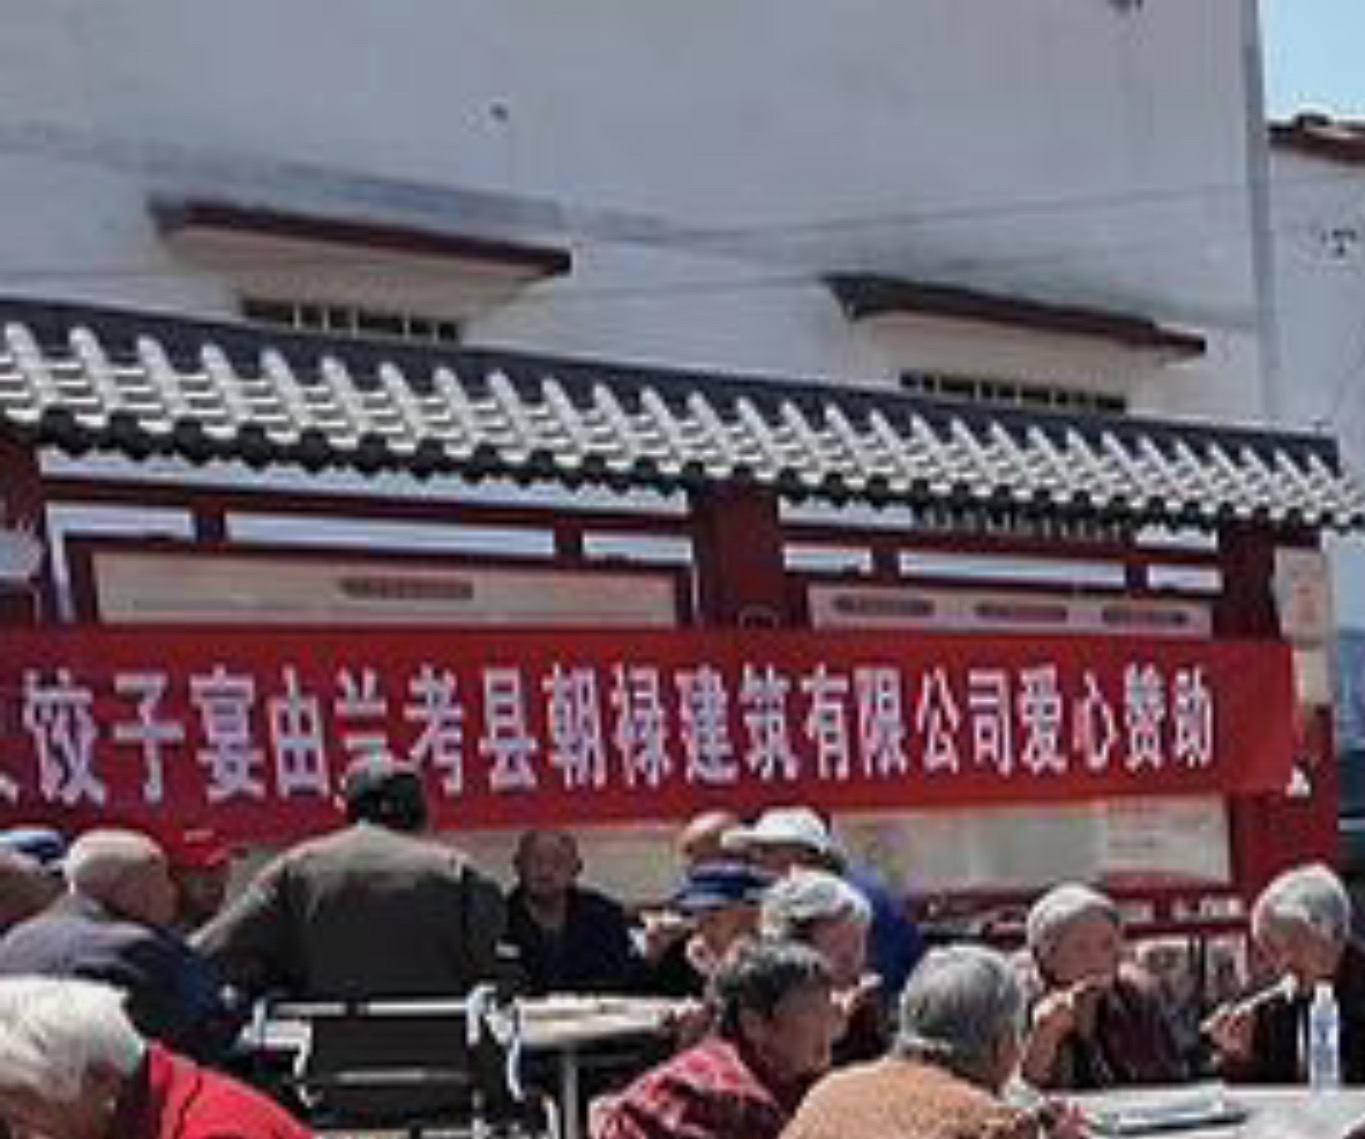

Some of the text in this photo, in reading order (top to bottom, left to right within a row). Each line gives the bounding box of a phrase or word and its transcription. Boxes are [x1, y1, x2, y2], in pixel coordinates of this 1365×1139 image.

[0, 661, 1213, 805] 饺子宴由兰考县朝禄建筑有限公司爱心赞助
